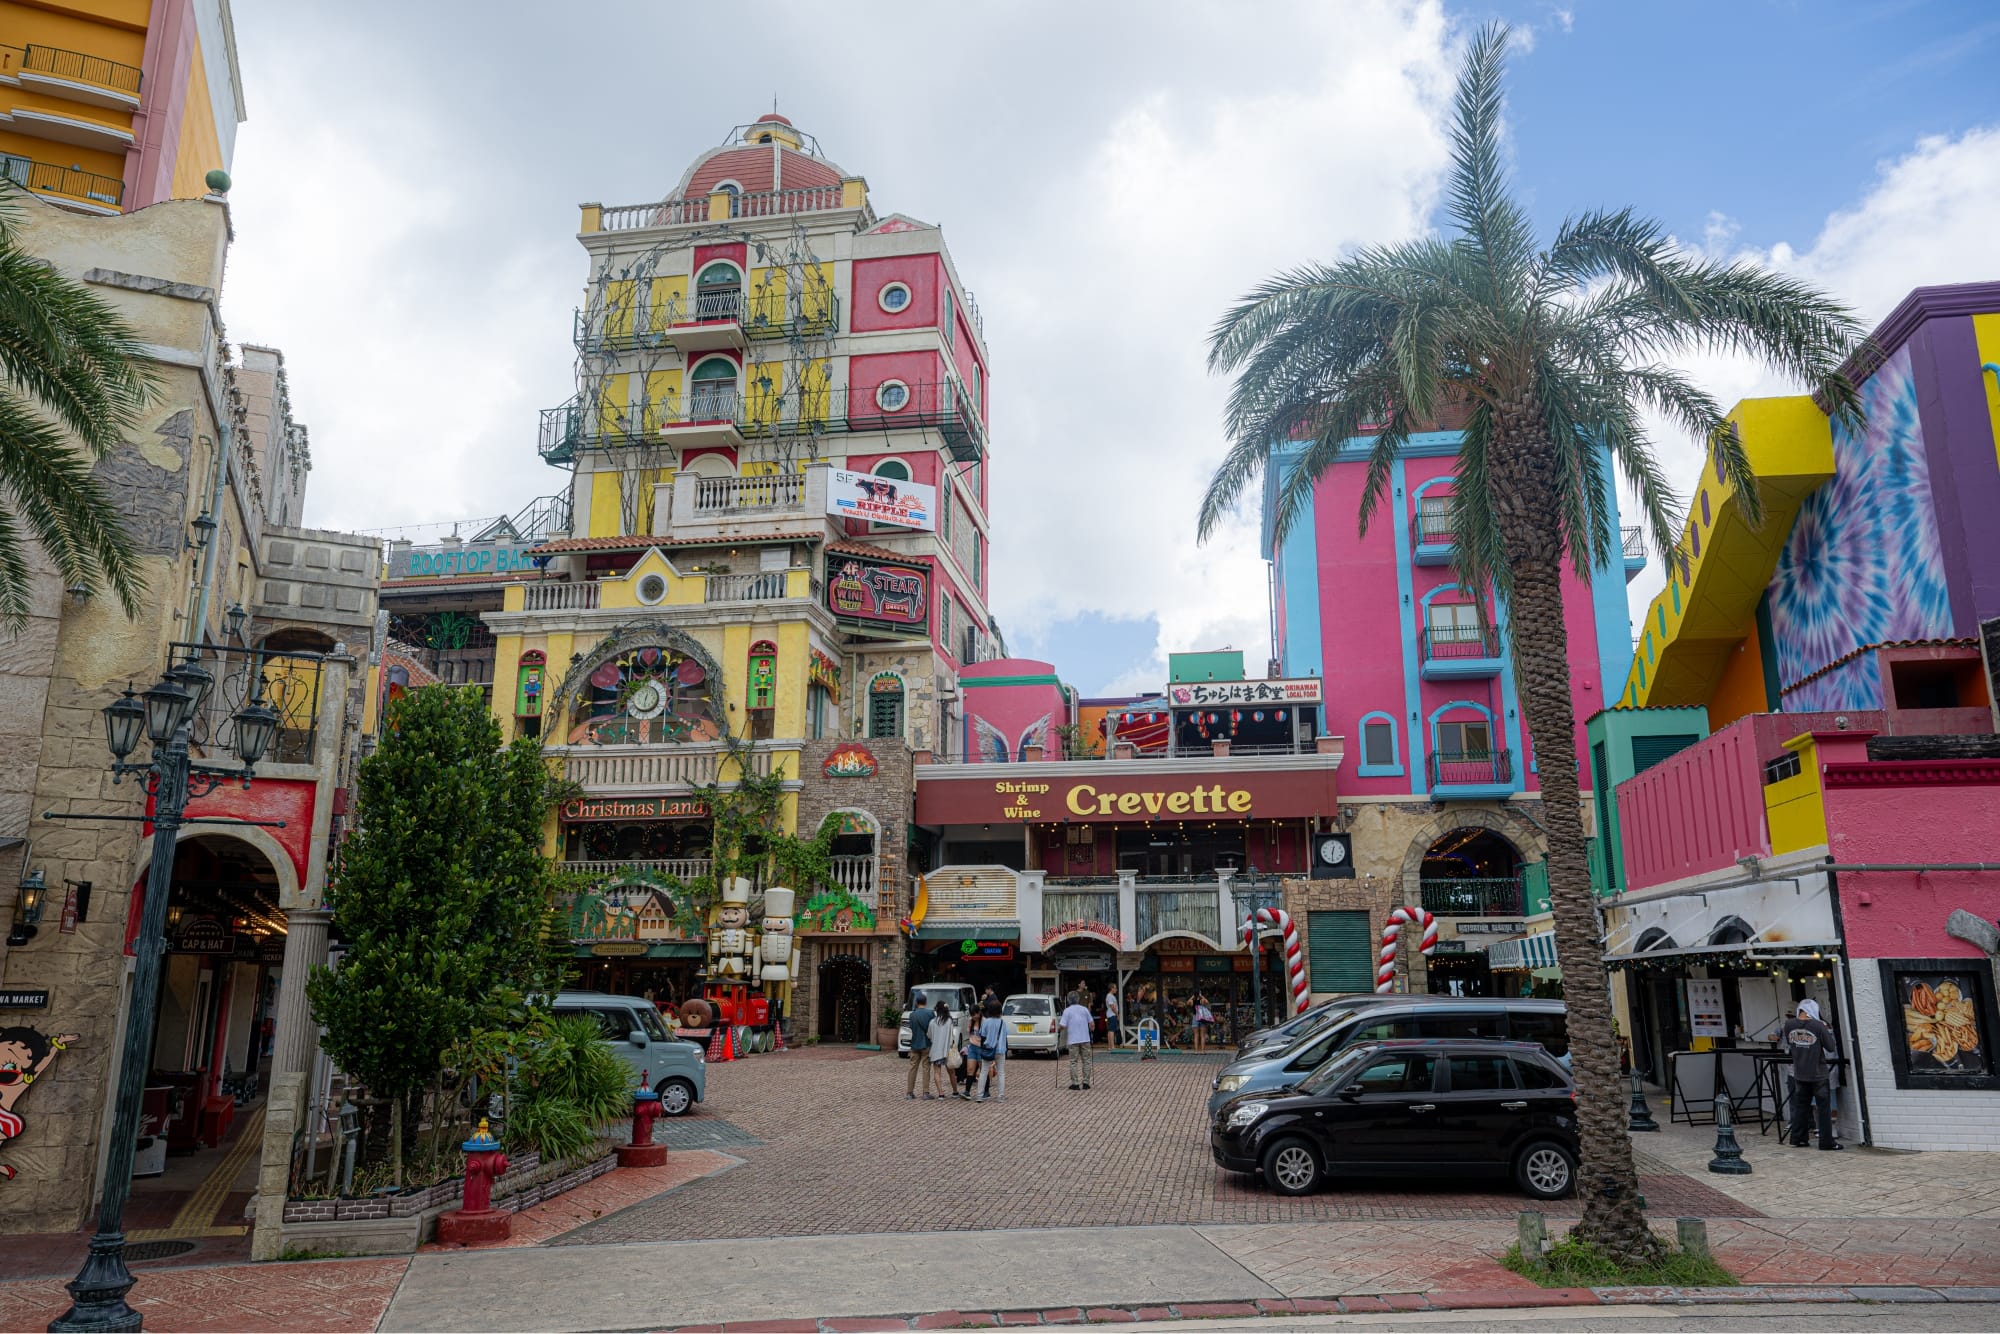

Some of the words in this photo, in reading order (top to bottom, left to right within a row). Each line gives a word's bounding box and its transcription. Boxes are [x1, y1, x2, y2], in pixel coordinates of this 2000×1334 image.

[856, 501, 909, 518] RIPPLE
[496, 548, 531, 571] BAR
[843, 561, 860, 576] 4F
[873, 575, 917, 595] STEAK
[1192, 682, 1285, 704] ちゅらはま食堂
[1285, 683, 1318, 691] OKINAWAN
[995, 781, 1050, 796] Shrimp
[1016, 793, 1029, 806] &
[1066, 784, 1252, 816] Crevette
[565, 799, 655, 818] Christmas
[660, 797, 705, 816] Land
[1003, 806, 1041, 819] Wine
[181, 938, 200, 950] CAP
[199, 939, 208, 951] &
[207, 938, 225, 951] HAT
[11, 995, 46, 1004] MARKET
